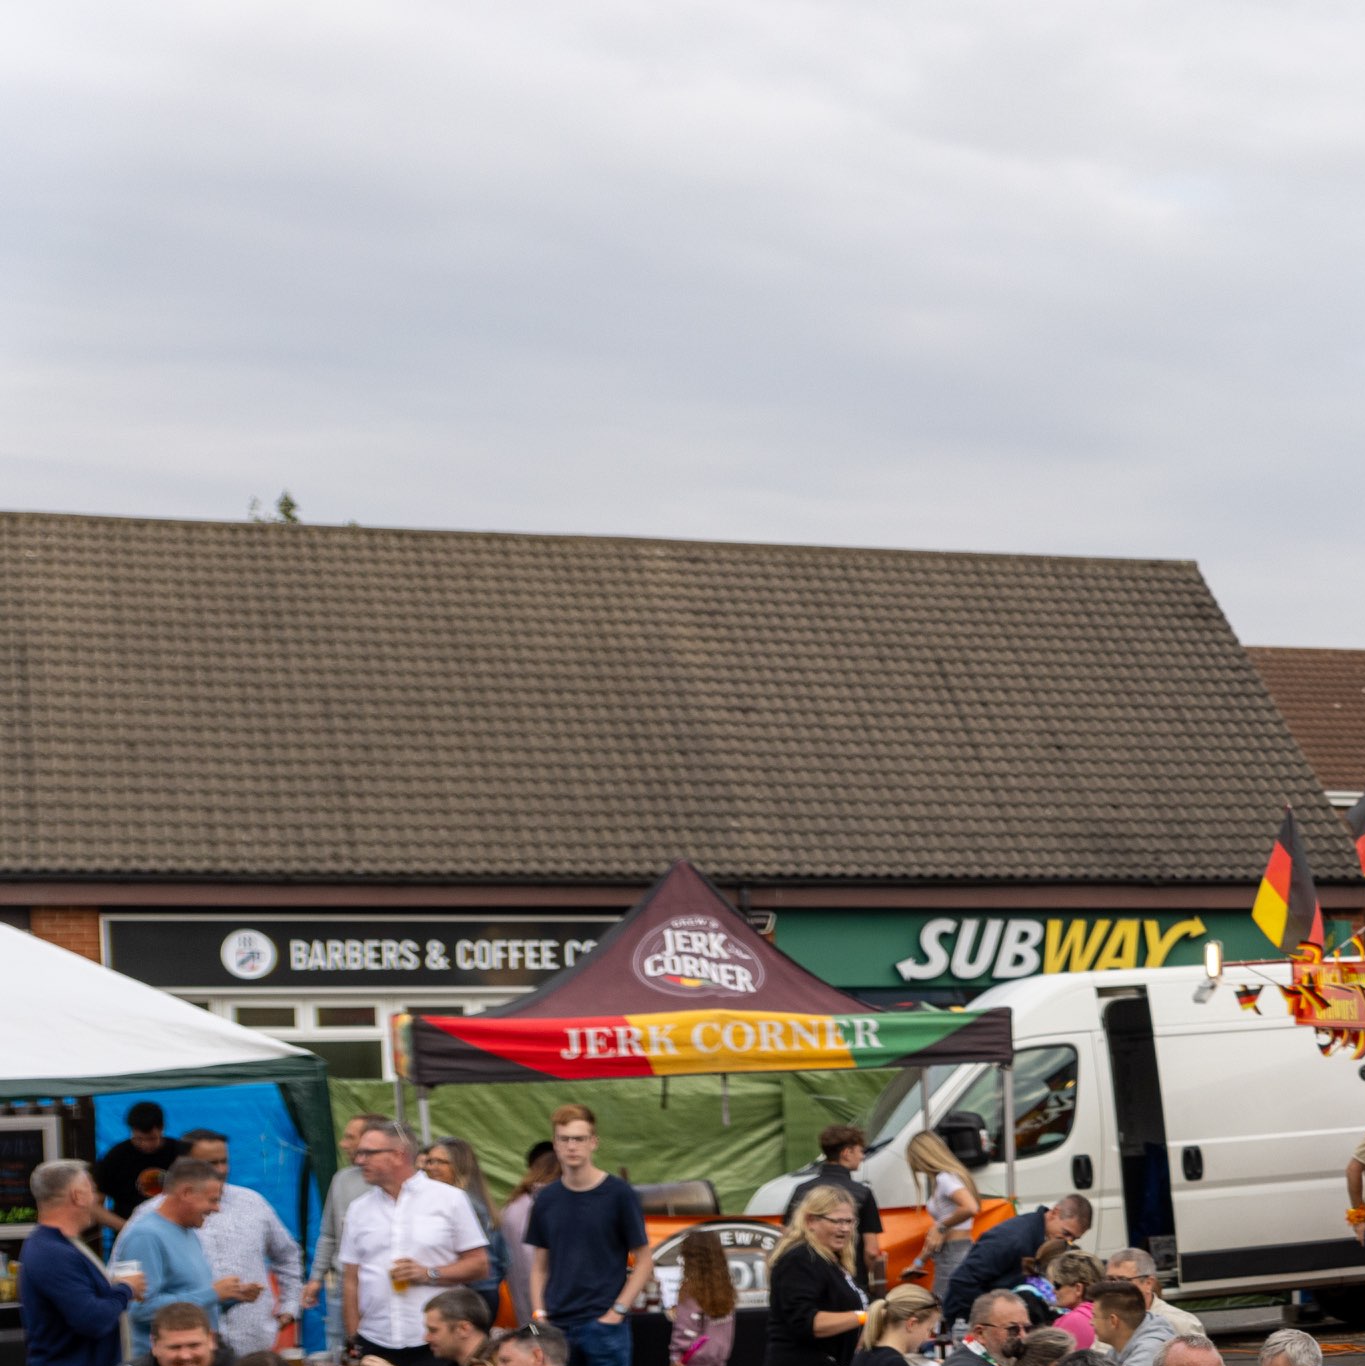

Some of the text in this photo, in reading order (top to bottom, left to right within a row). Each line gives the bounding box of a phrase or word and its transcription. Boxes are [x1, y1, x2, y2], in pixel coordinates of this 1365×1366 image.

[289, 938, 421, 970] BARBERS
[425, 938, 450, 970] &
[455, 938, 560, 970] COFFEE
[662, 928, 731, 960] JERK
[895, 916, 1207, 981] SUBWAY
[644, 953, 757, 993] CORNER
[559, 1017, 885, 1060] JERK CORNER
[720, 1231, 776, 1250] EW'S
